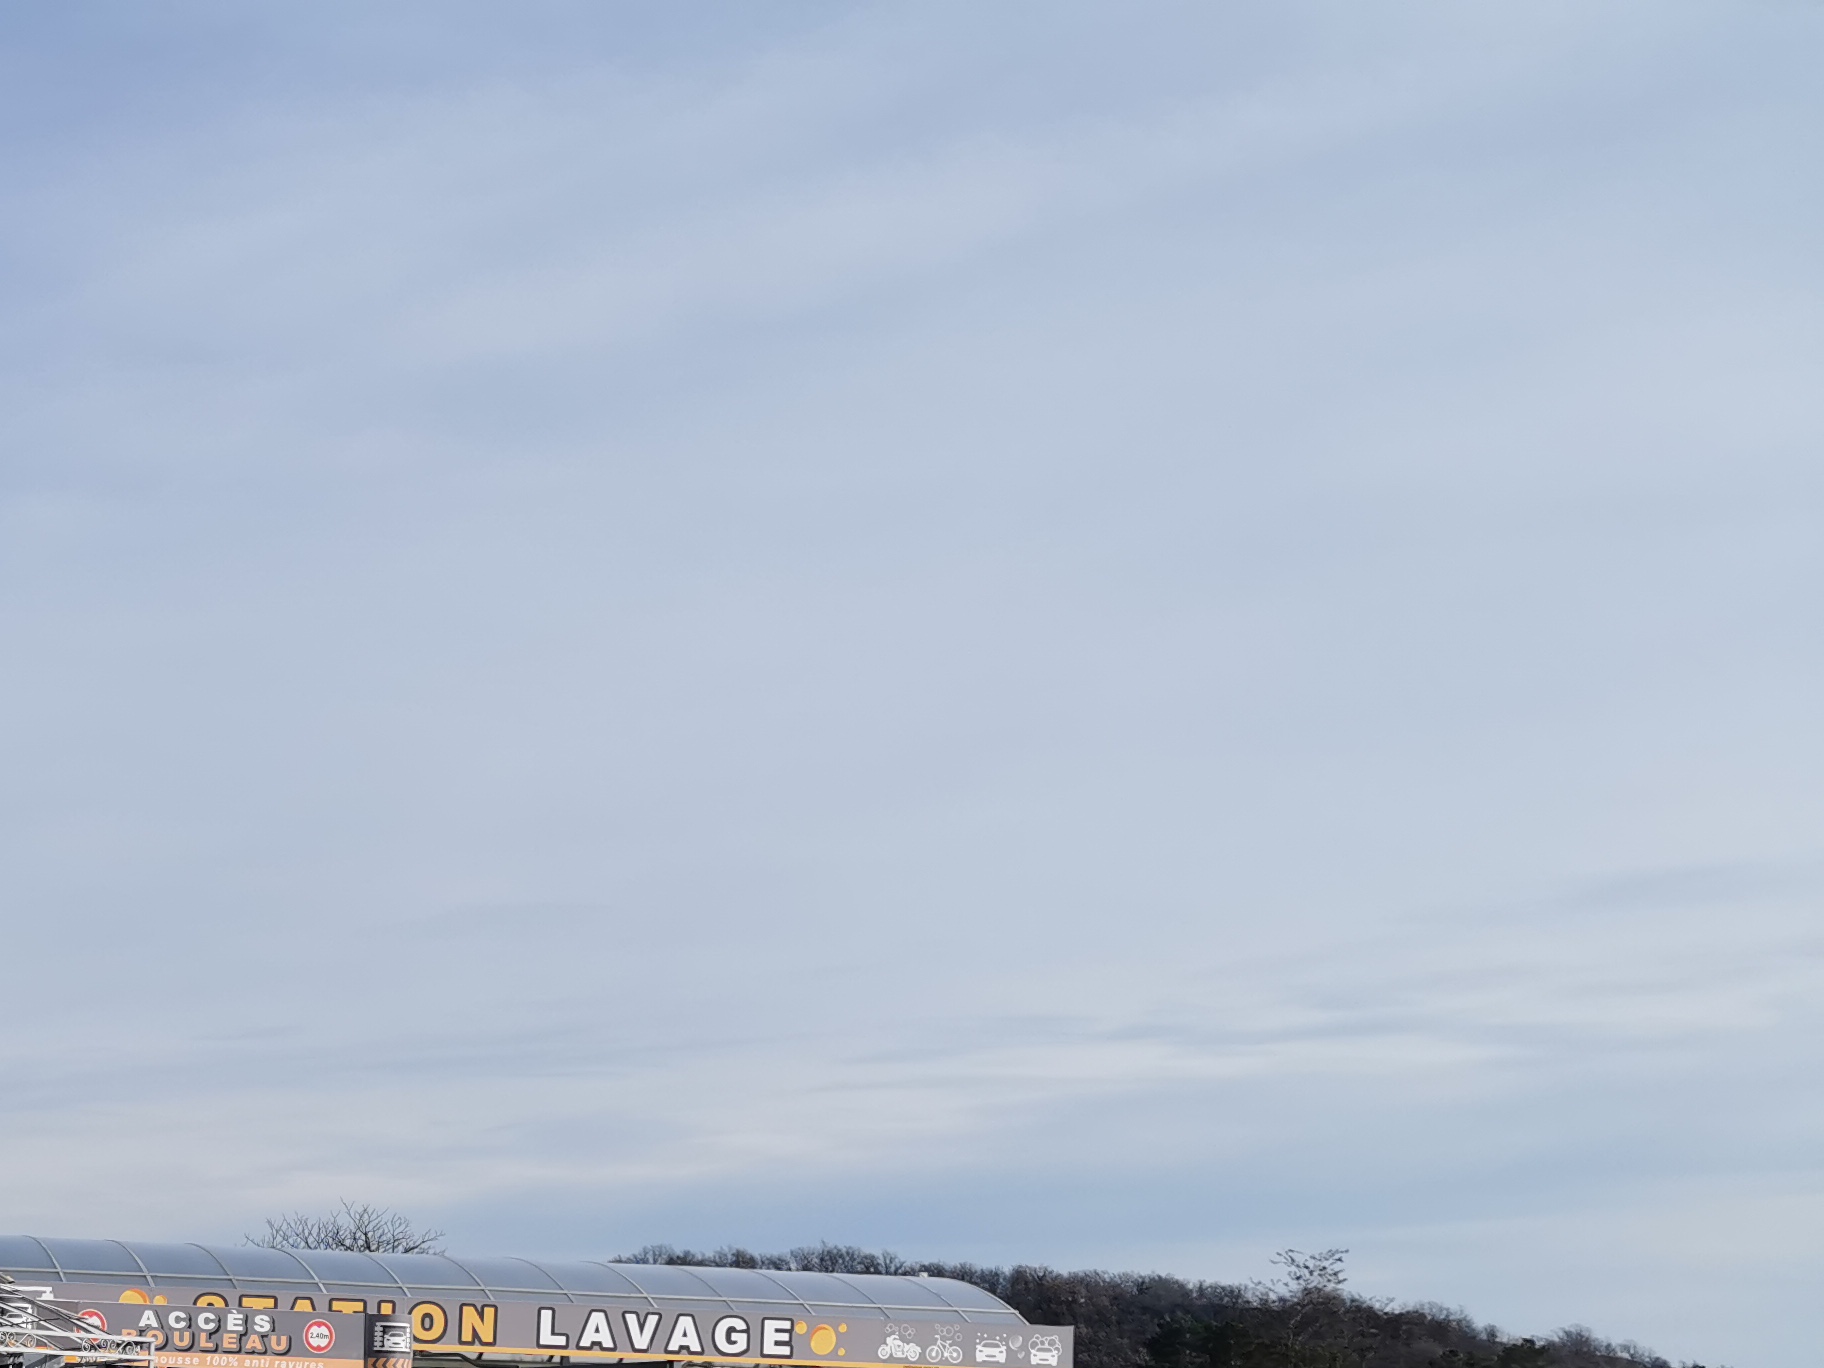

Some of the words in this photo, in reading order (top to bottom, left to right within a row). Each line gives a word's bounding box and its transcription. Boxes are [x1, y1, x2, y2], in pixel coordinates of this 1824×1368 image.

[138, 1309, 273, 1333] ACCÈS
[309, 1331, 330, 1340] 2.40m
[537, 1308, 793, 1357] LAVAGE
[206, 1355, 238, 1367] 100%
[244, 1357, 270, 1368] anti
